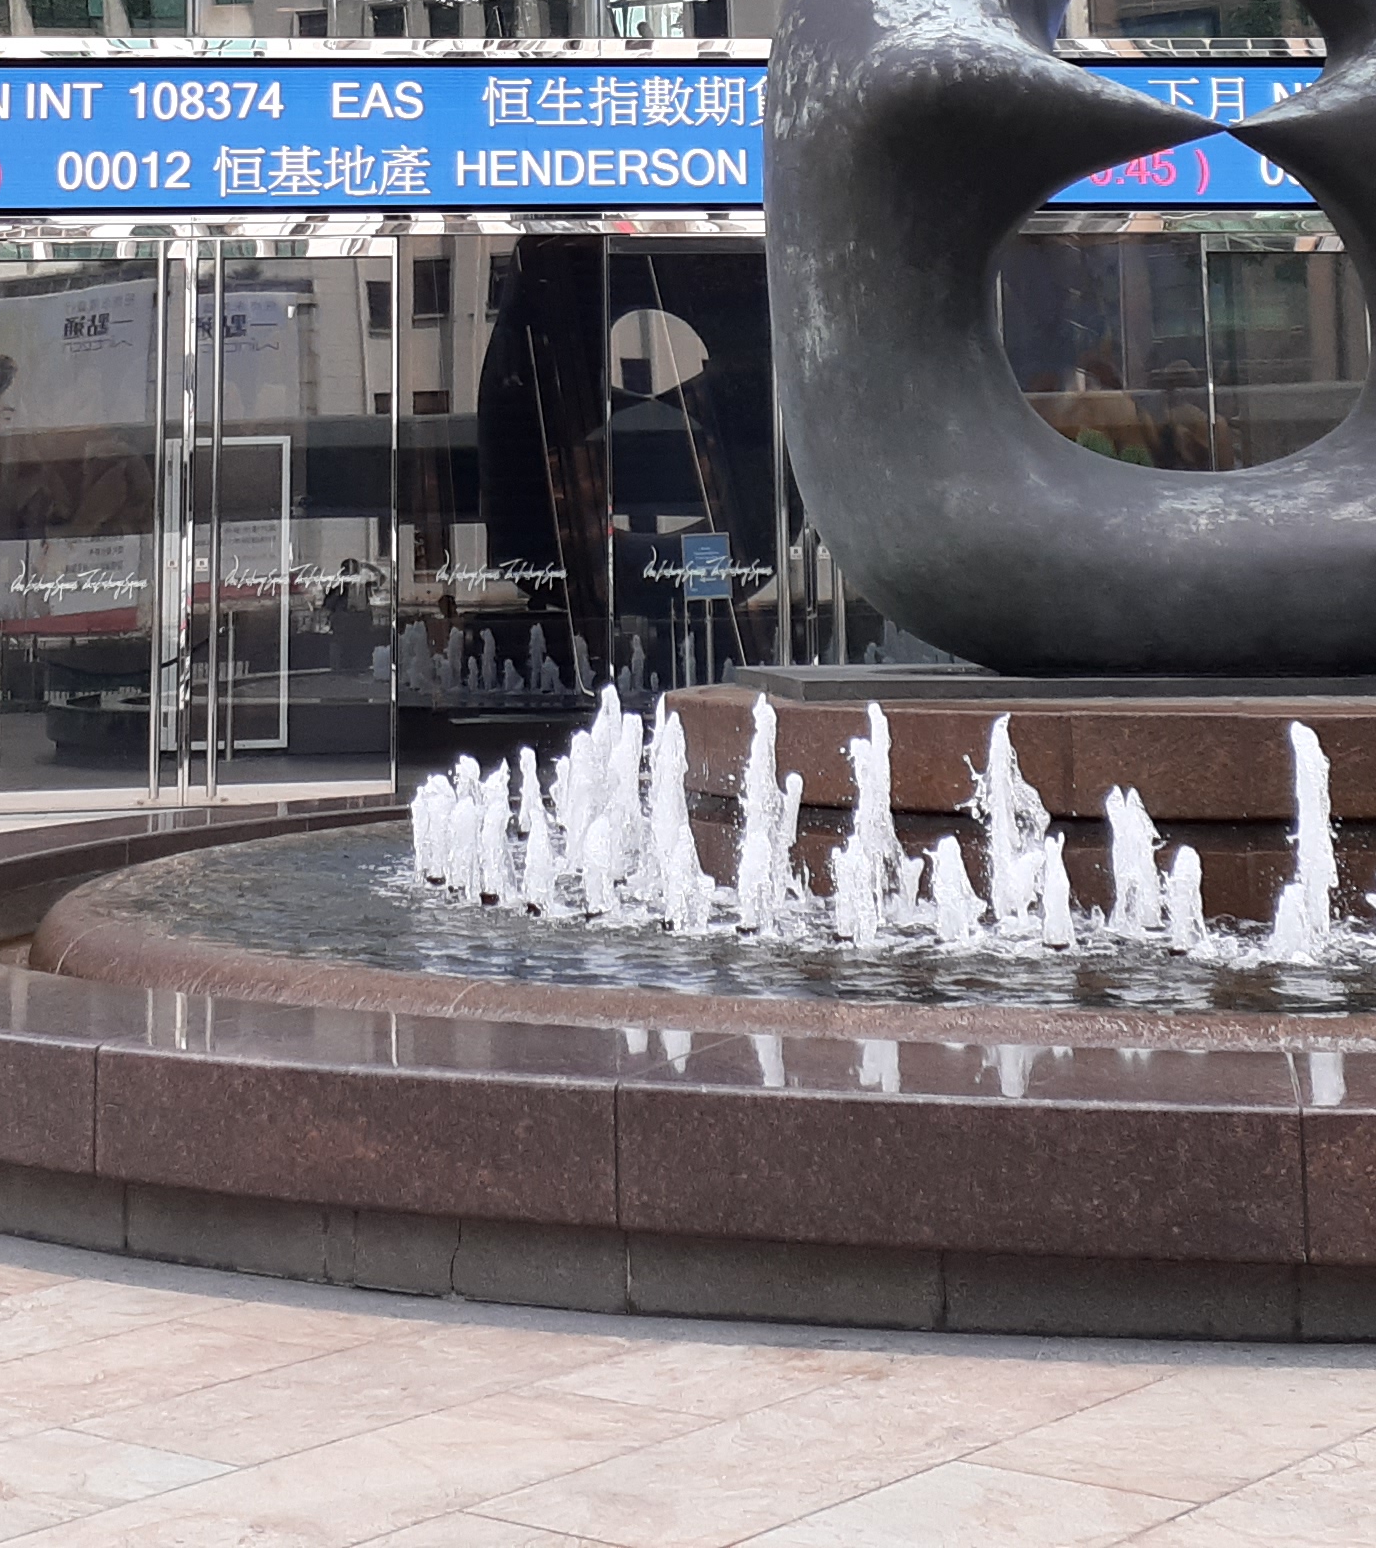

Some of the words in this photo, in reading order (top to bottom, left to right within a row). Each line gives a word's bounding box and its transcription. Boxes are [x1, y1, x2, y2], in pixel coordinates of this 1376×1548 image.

[26, 83, 103, 119] INT
[129, 81, 284, 120] 108374
[332, 81, 424, 119] EAS
[1147, 77, 1246, 122] 下月
[57, 151, 191, 190] 00012
[457, 148, 747, 186] HENDERSON
